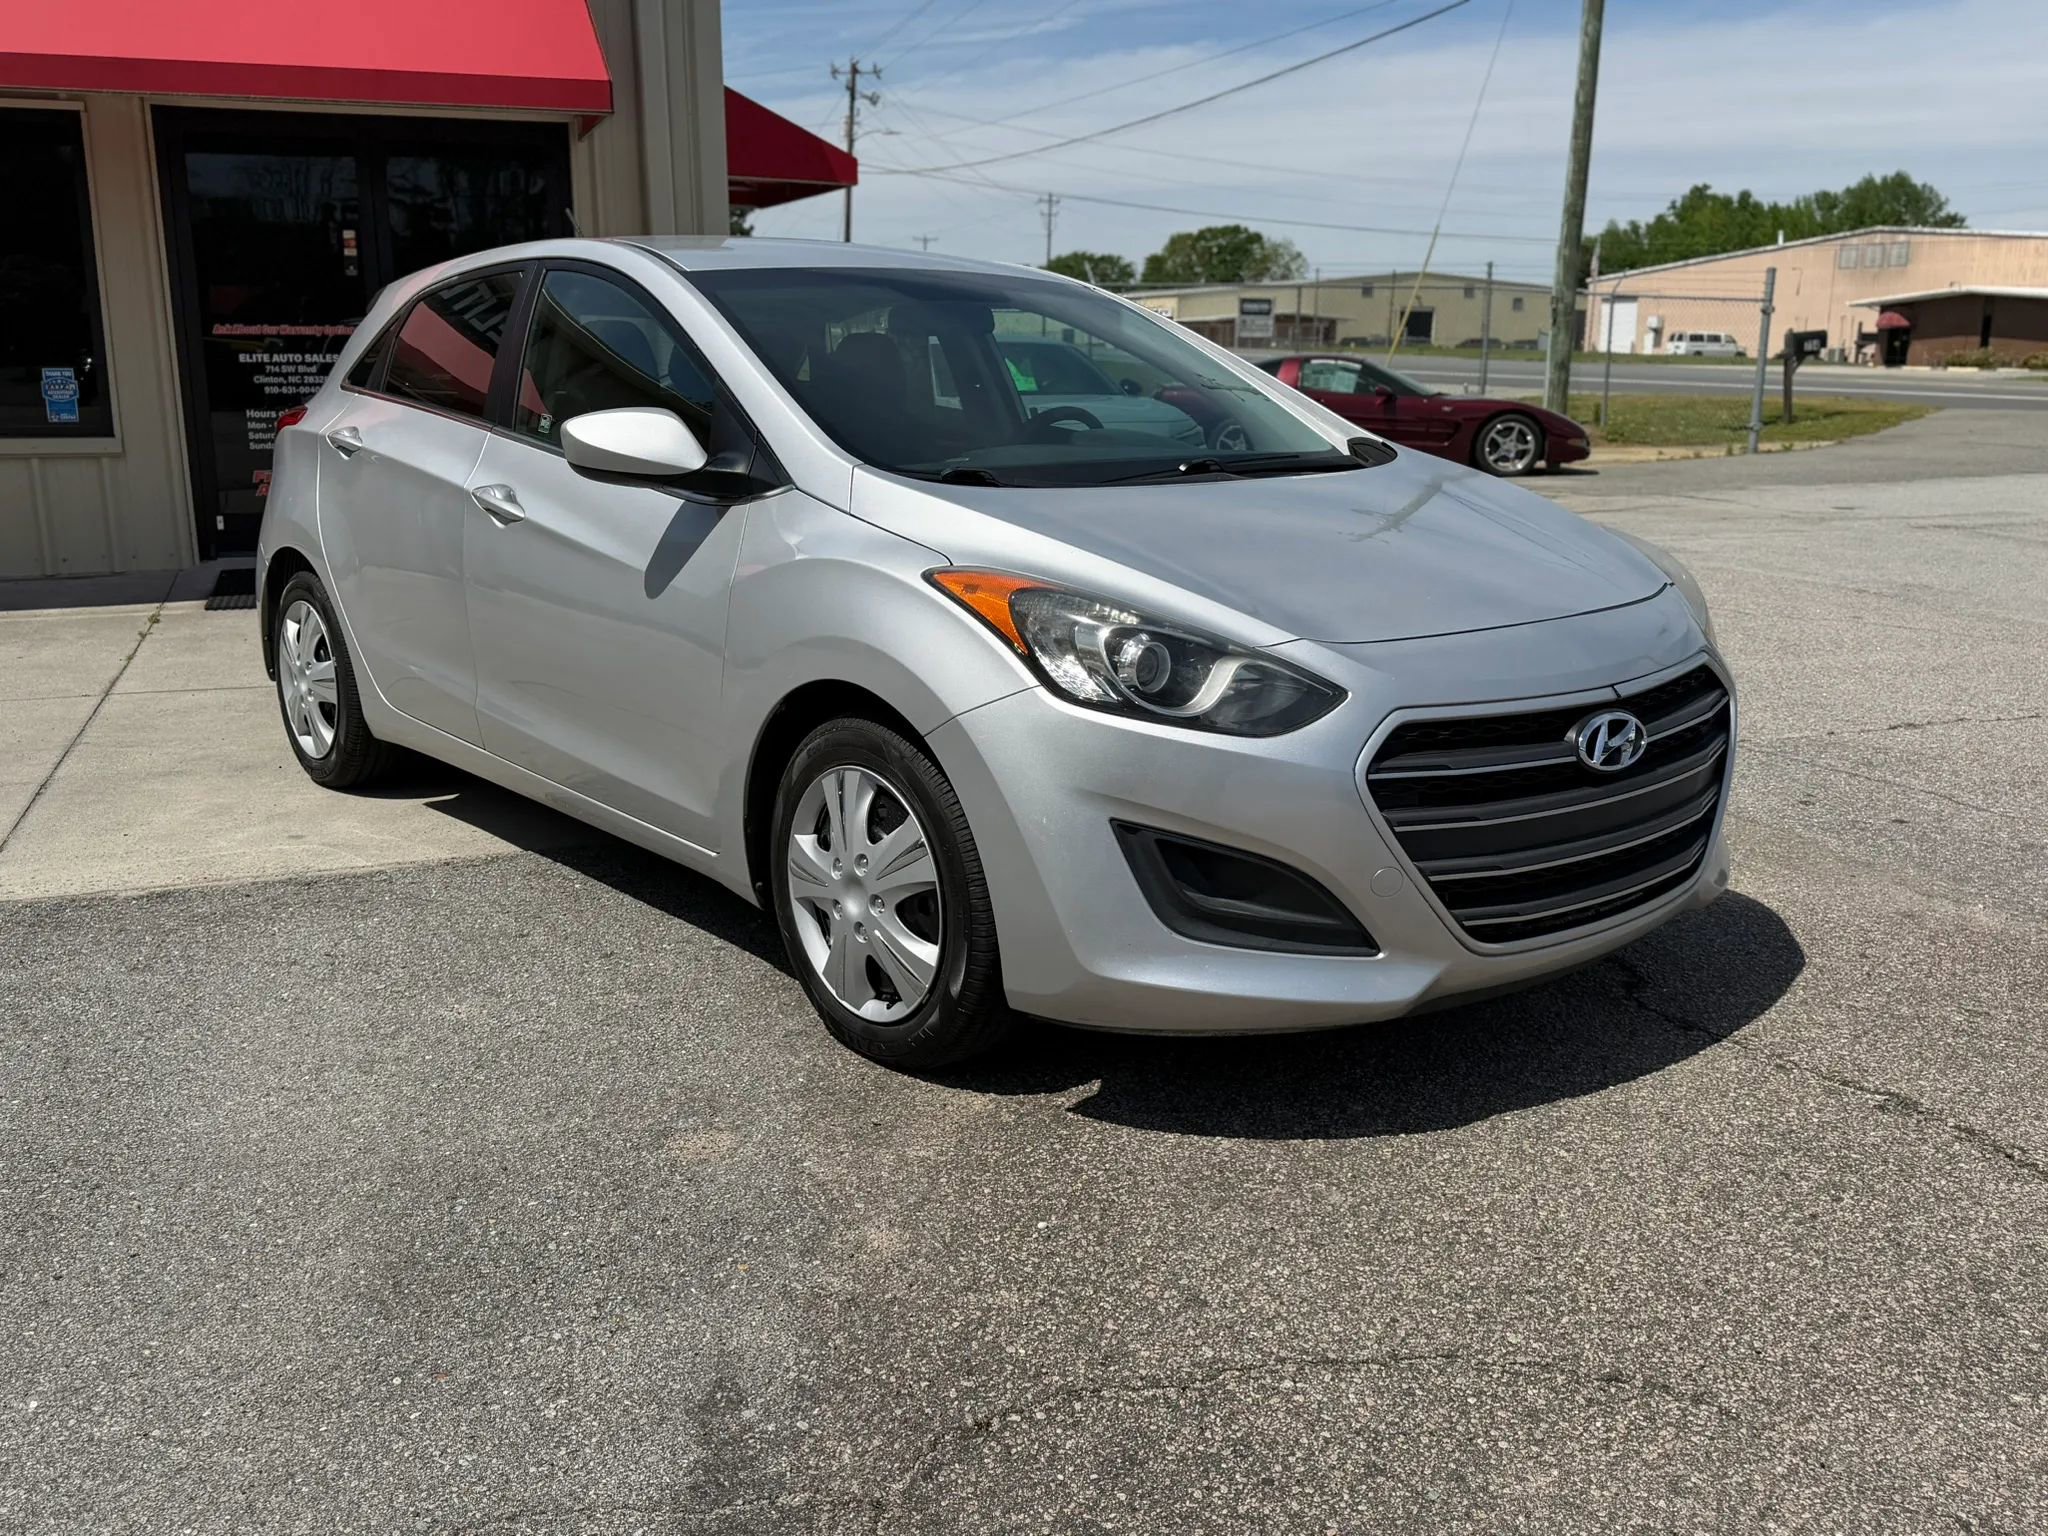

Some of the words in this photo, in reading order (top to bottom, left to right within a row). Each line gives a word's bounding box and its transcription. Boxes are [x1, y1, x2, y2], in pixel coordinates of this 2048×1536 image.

[239, 354, 270, 362] ELITE
[272, 354, 302, 362] AUTO
[265, 365, 279, 373] 714
[281, 365, 296, 373] SW
[297, 365, 317, 373] Blvd
[253, 375, 287, 384] Clinton,
[246, 409, 277, 418] Hours
[247, 421, 267, 429] Mon
